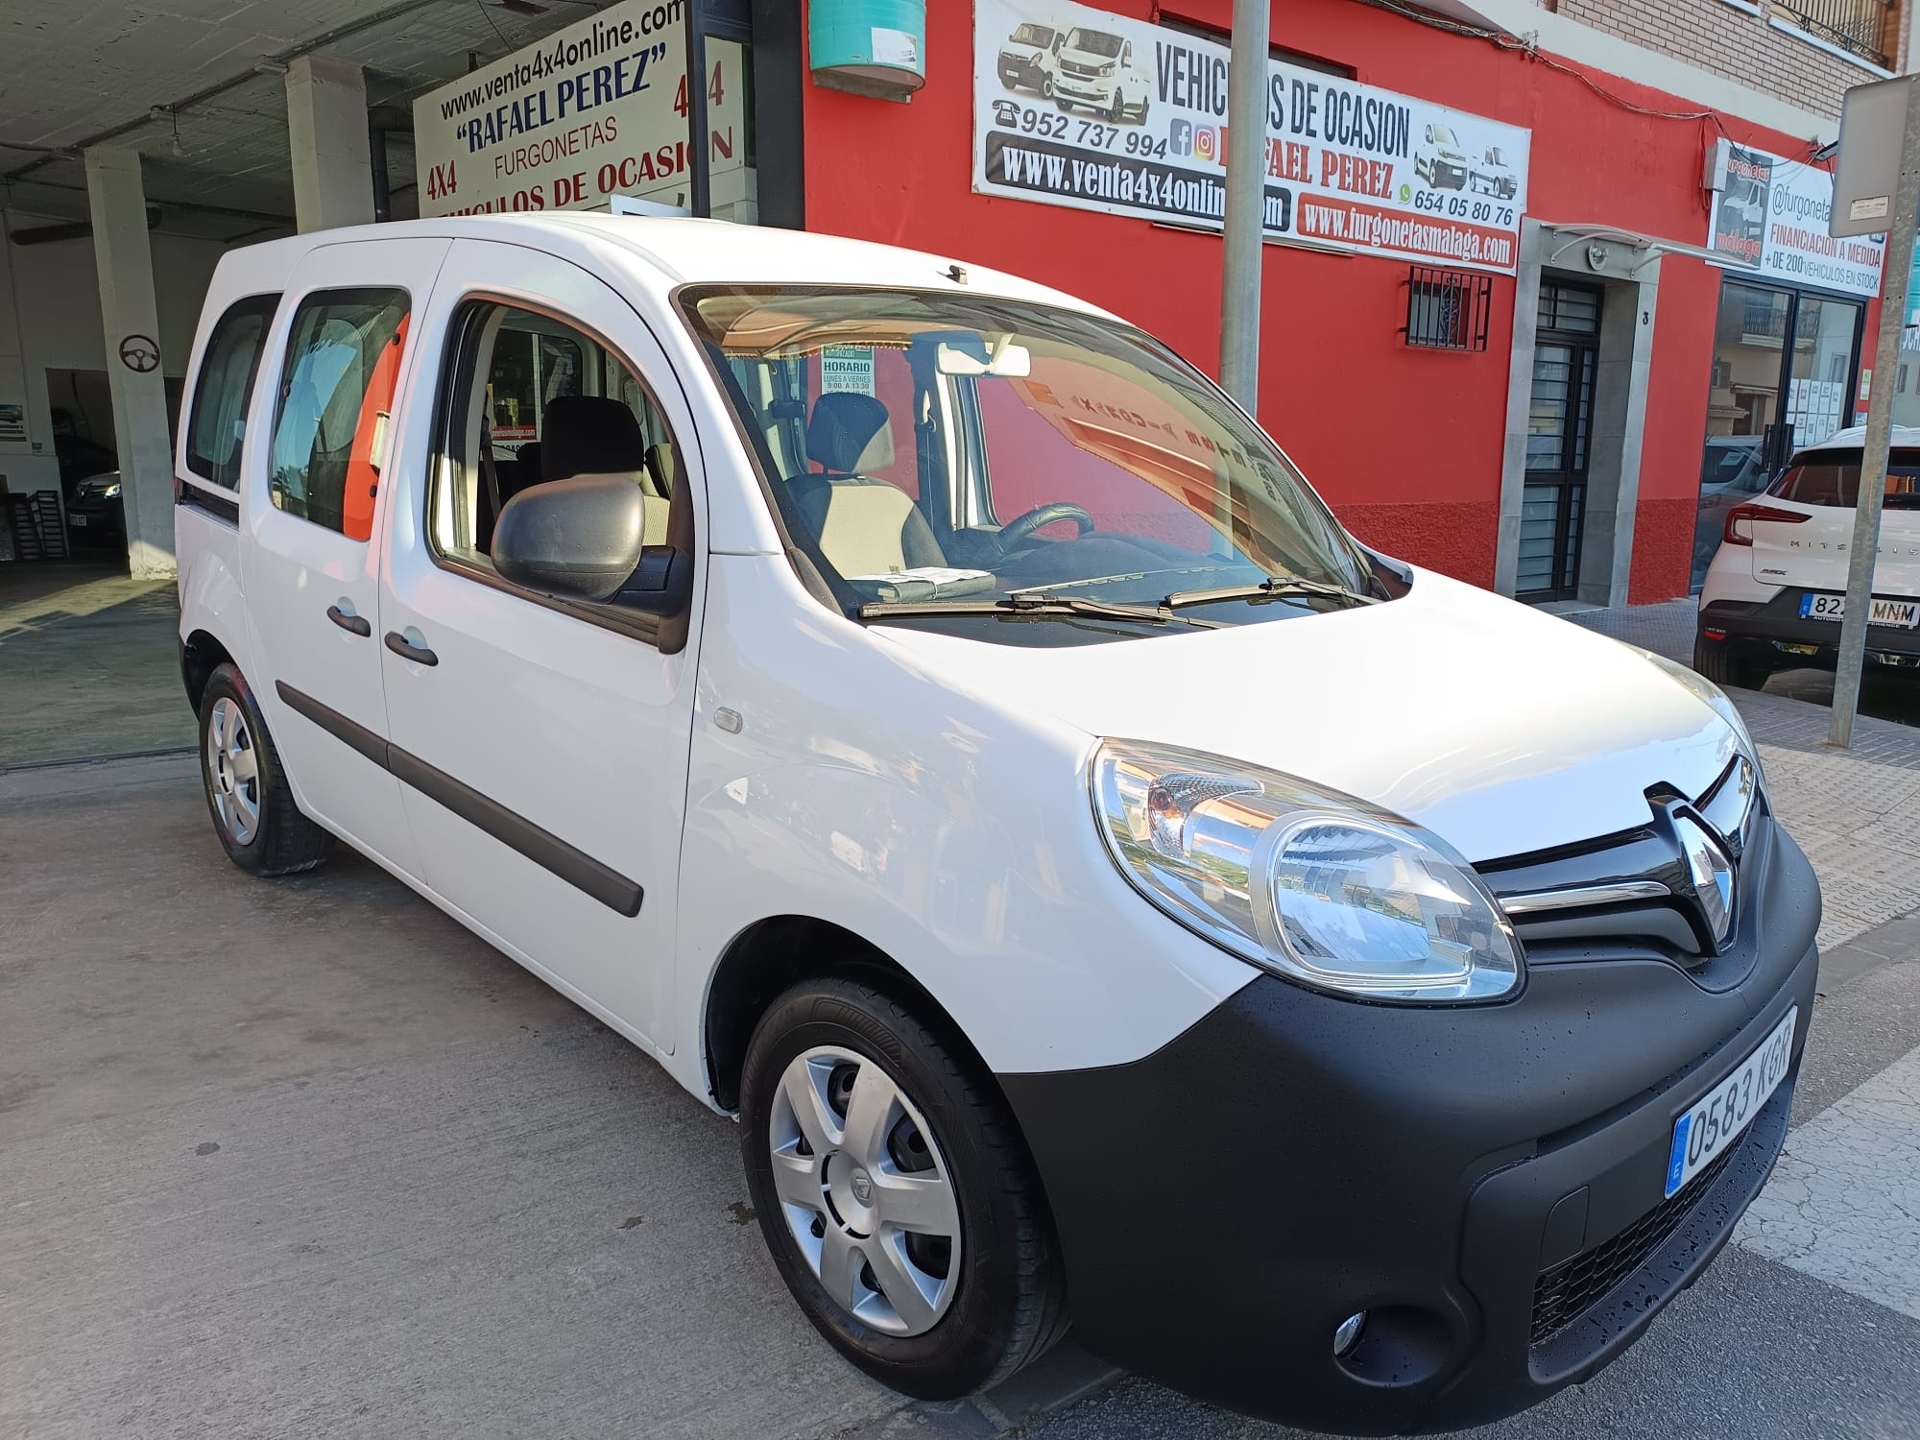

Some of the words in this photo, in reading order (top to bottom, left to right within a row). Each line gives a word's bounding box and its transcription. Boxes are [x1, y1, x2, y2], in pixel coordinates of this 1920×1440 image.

[440, 0, 686, 121] www.venta4x4online.com
[1021, 109, 1069, 140] 952
[1077, 120, 1119, 149] 737
[1125, 131, 1167, 160] 994
[1291, 79, 1319, 138] DE
[1324, 88, 1410, 158] OCASION
[494, 116, 618, 180] FURGONETAS
[427, 160, 457, 200] 4X4
[554, 172, 588, 208] DE
[1320, 149, 1394, 199] PEREZ
[1414, 190, 1444, 212] 654
[1448, 197, 1468, 217] 05
[1471, 202, 1491, 221] 80
[1495, 206, 1513, 226] 76
[1304, 203, 1510, 264] www.furgonetasmalaga.com
[1770, 223, 1838, 258] FINANCIACION
[1839, 241, 1845, 260] A
[1847, 243, 1880, 268] MEDIDA
[1772, 251, 1784, 269] DE
[1786, 254, 1803, 273] 200
[1803, 260, 1844, 283] VEHICULOS
[1846, 269, 1856, 285] EN
[1856, 272, 1879, 290] STOCK
[1642, 311, 1649, 325] 3
[824, 361, 870, 372] HORARIO
[1872, 602, 1915, 622] MNM
[1673, 1162, 1681, 1179] E
[1688, 1068, 1752, 1167] 0583
